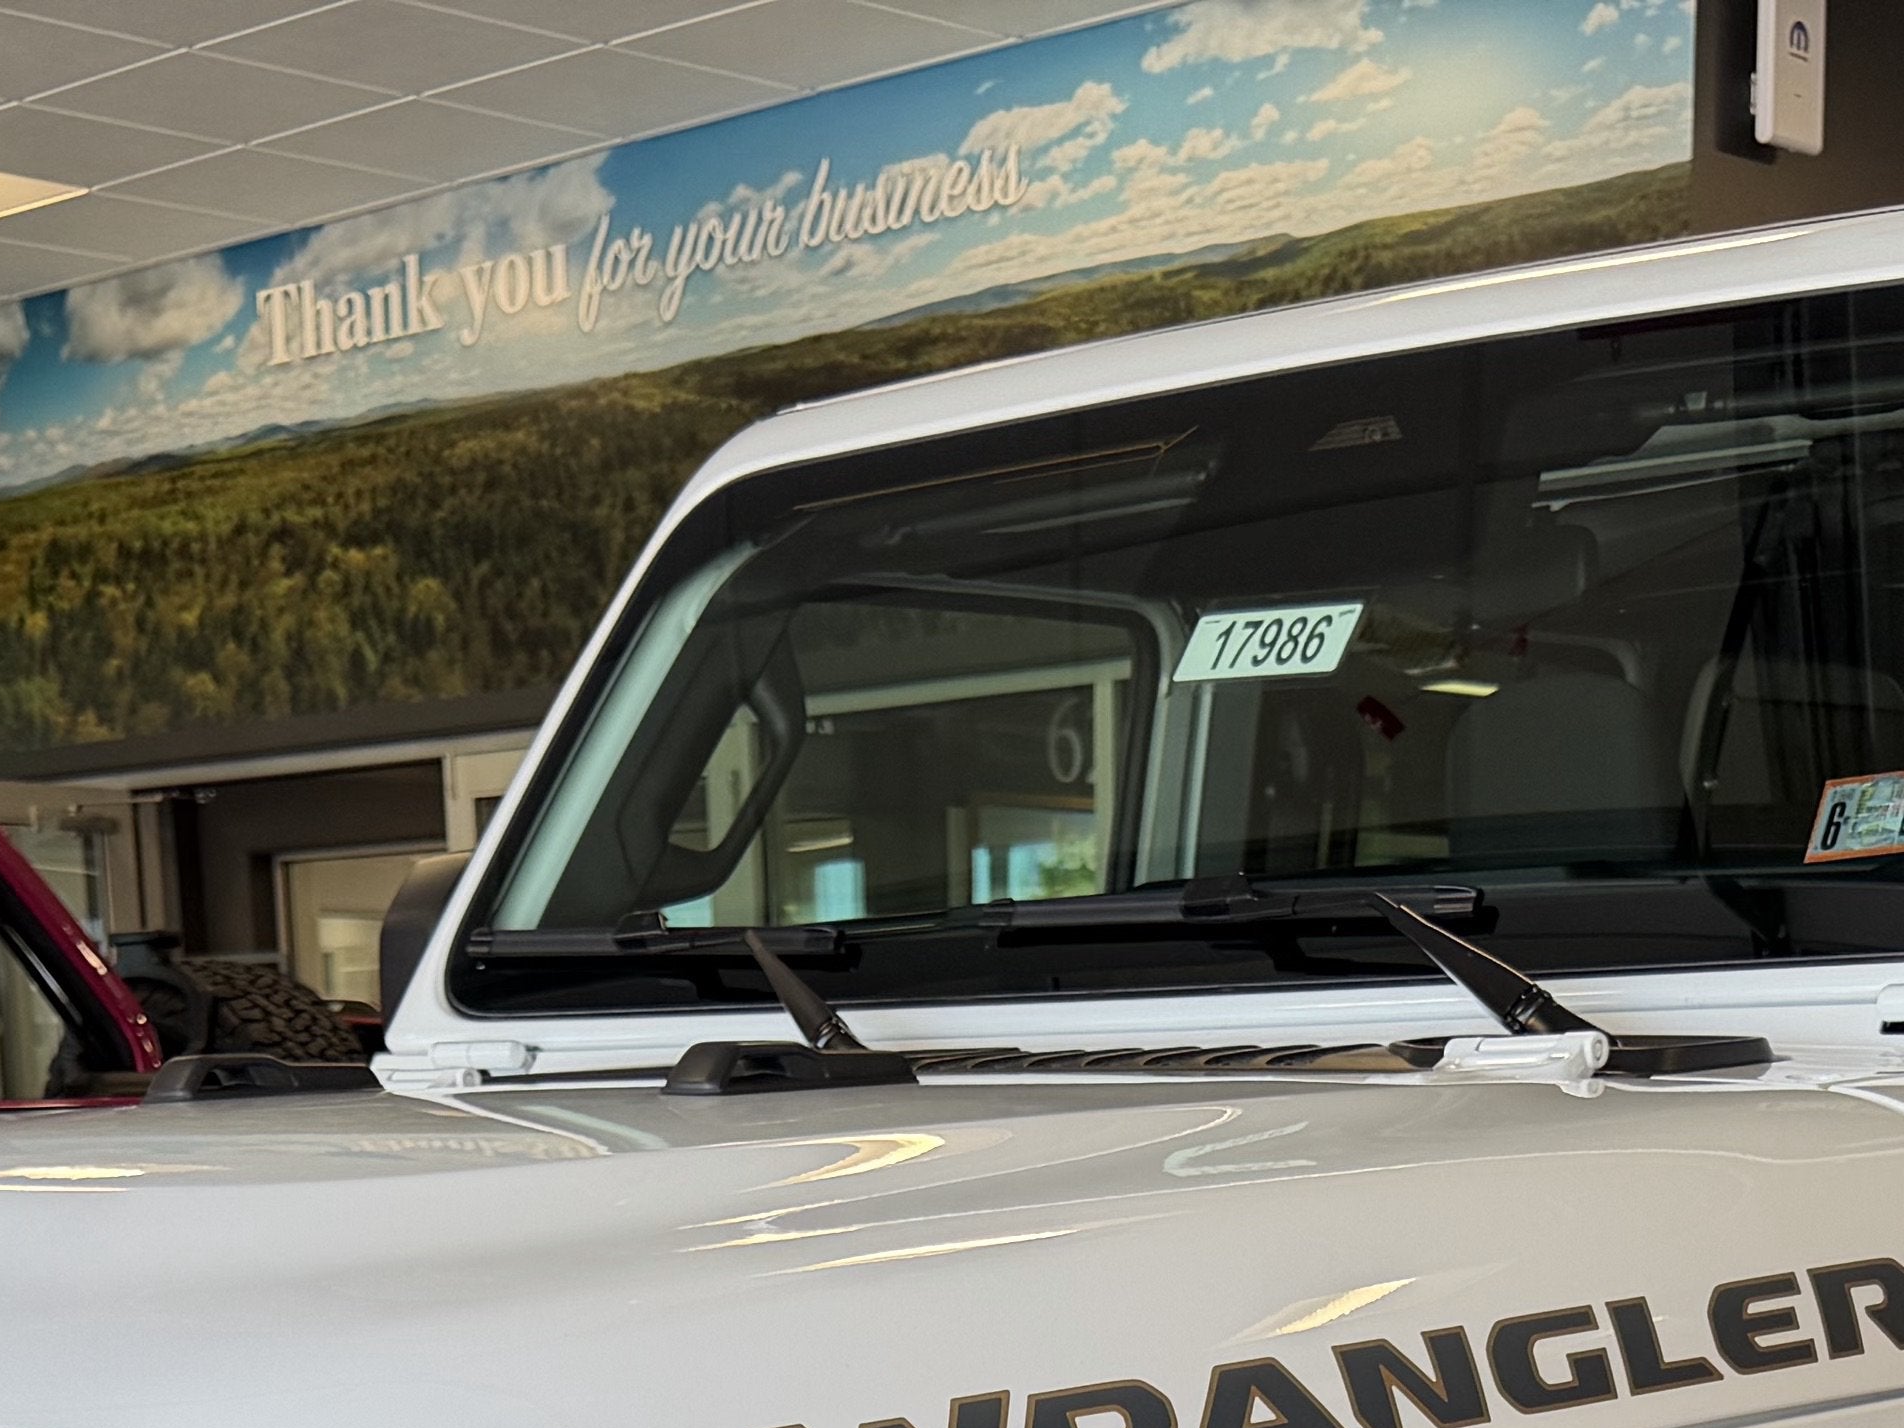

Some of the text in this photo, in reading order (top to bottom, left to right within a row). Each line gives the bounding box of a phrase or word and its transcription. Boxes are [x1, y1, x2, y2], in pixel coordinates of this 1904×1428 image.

[256, 157, 1031, 366] Thank you for your business
[1210, 613, 1334, 670] 17986
[1049, 696, 1095, 784] 6
[1820, 801, 1847, 851] 6
